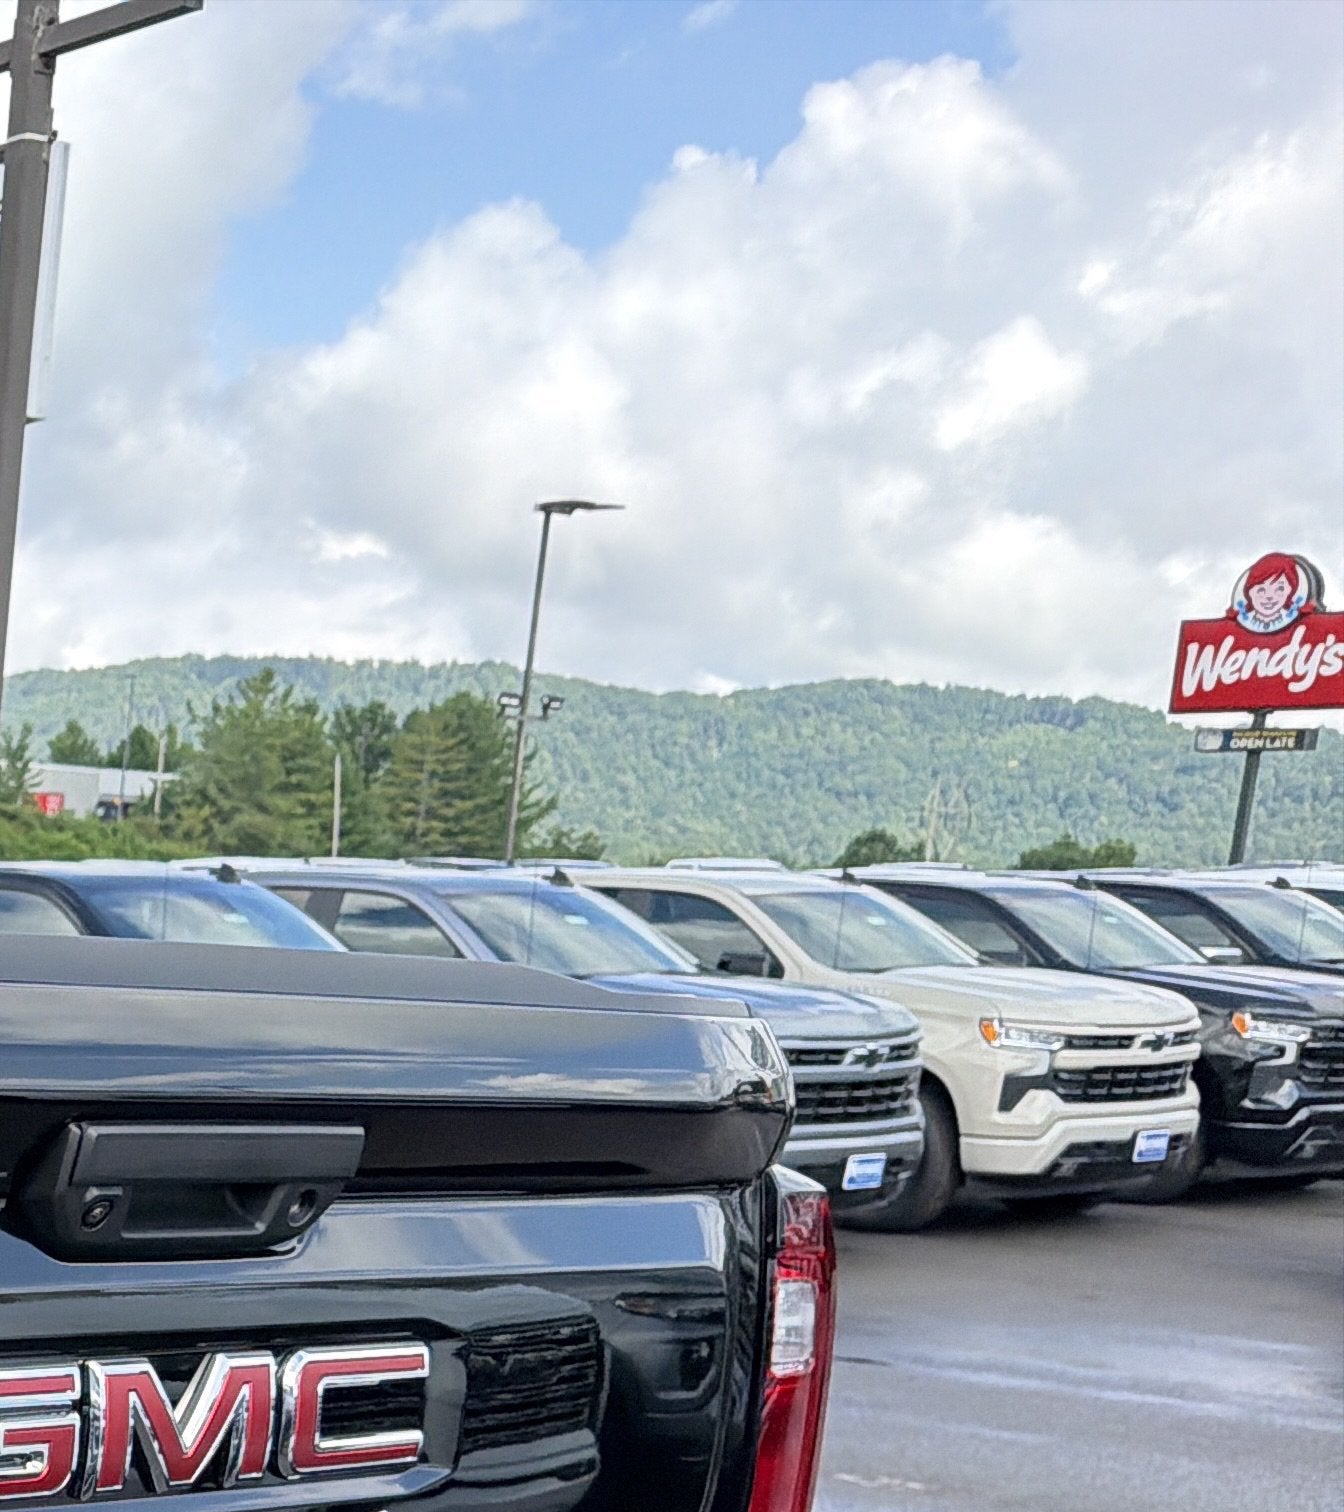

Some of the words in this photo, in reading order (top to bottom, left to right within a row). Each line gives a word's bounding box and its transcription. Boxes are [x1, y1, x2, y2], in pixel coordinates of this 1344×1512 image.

[1182, 625, 1344, 697] Wendy's
[1230, 737, 1264, 749] OPEN
[1266, 736, 1295, 749] LATE
